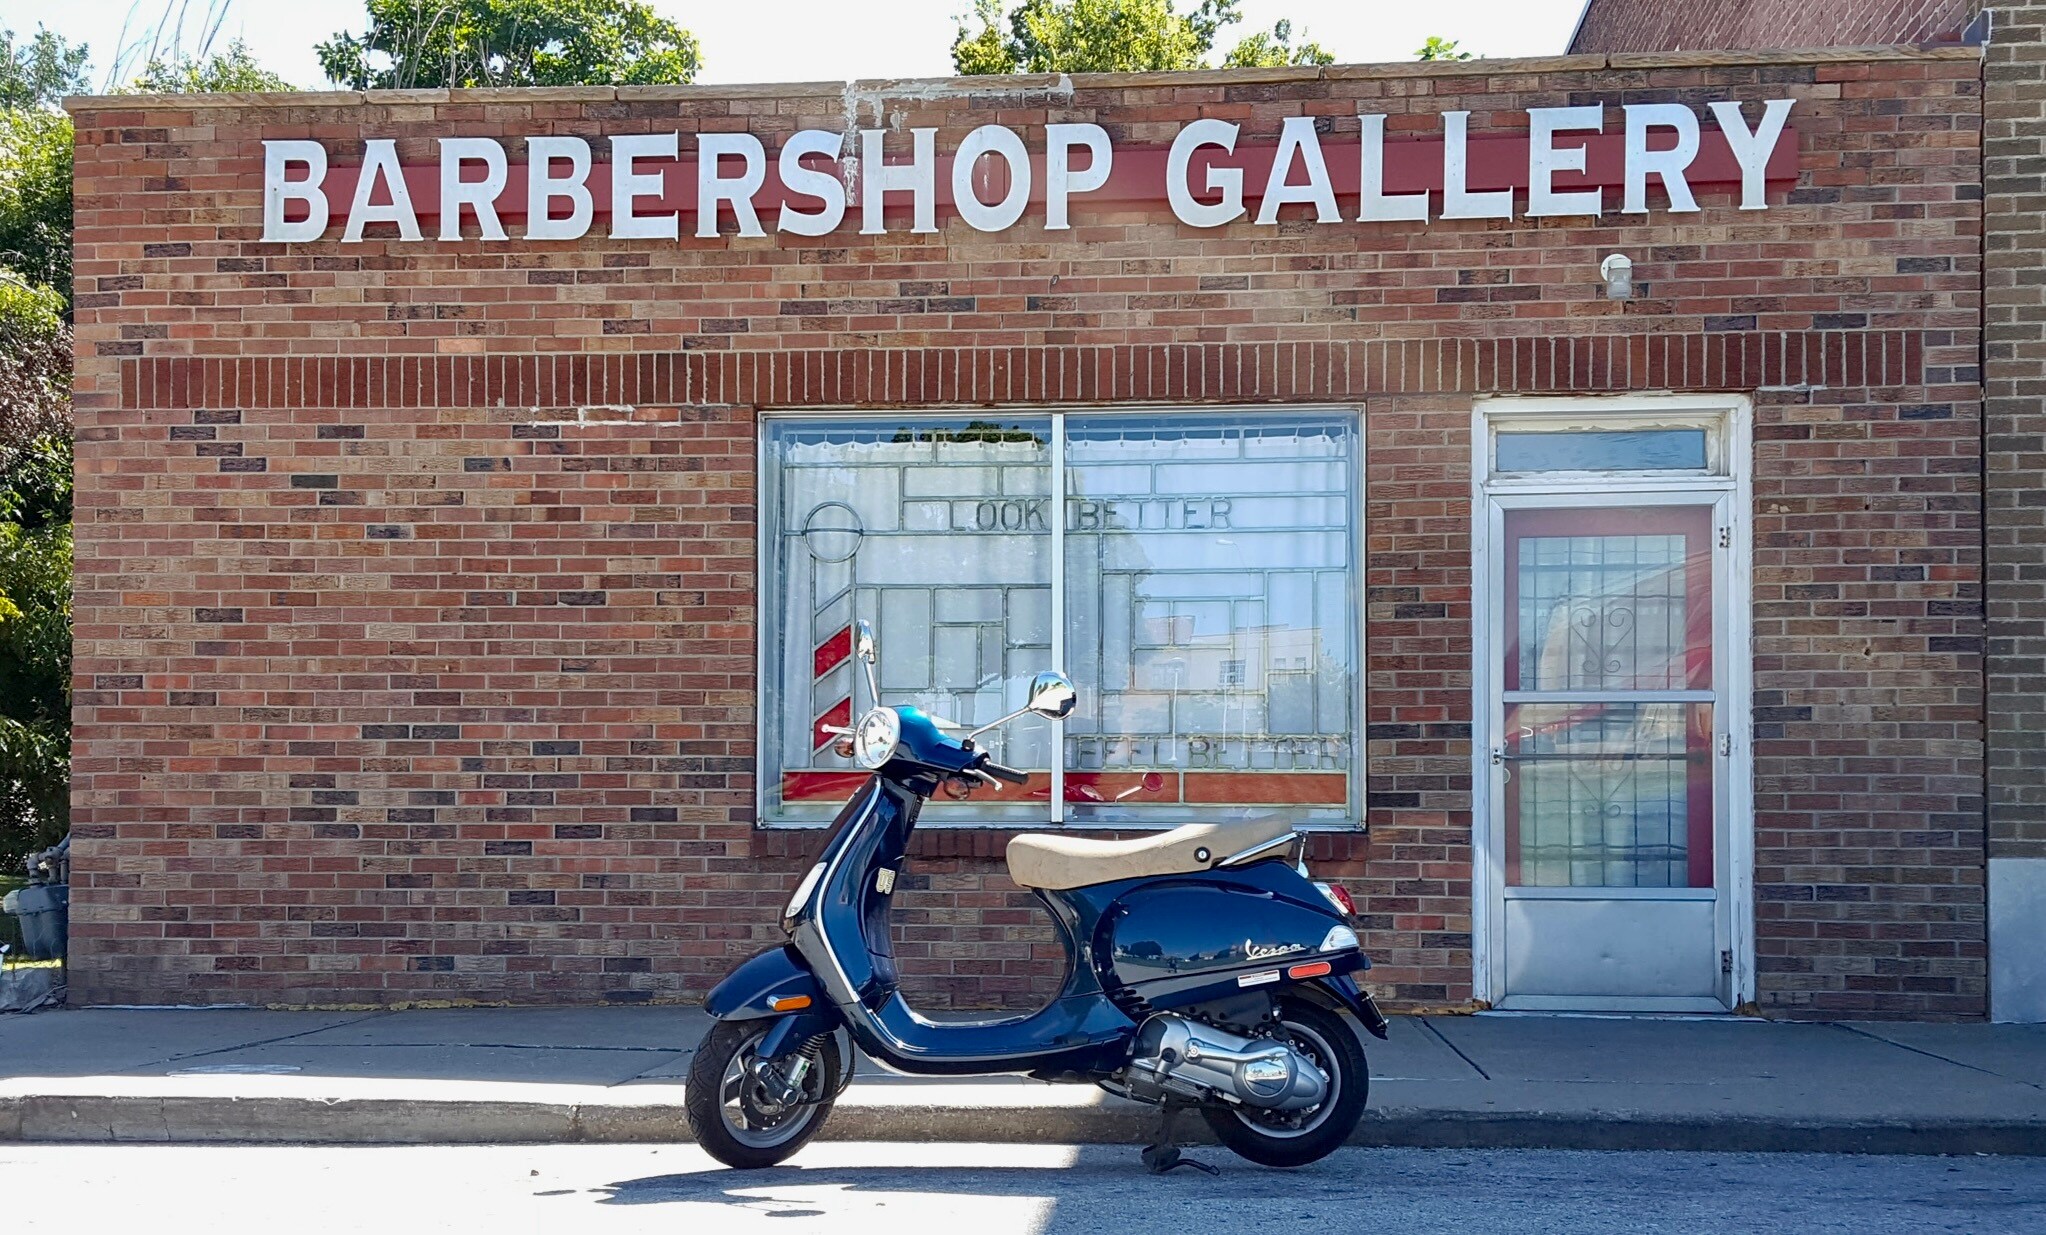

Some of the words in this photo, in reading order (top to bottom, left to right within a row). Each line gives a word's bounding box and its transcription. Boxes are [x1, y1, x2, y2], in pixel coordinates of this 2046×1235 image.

[259, 122, 1114, 243] BARBERSHOP
[1165, 98, 1797, 227] GALLERY
[949, 498, 1047, 532] LOOK
[1078, 497, 1233, 531] BETTER
[1245, 938, 1306, 960] Vespa
